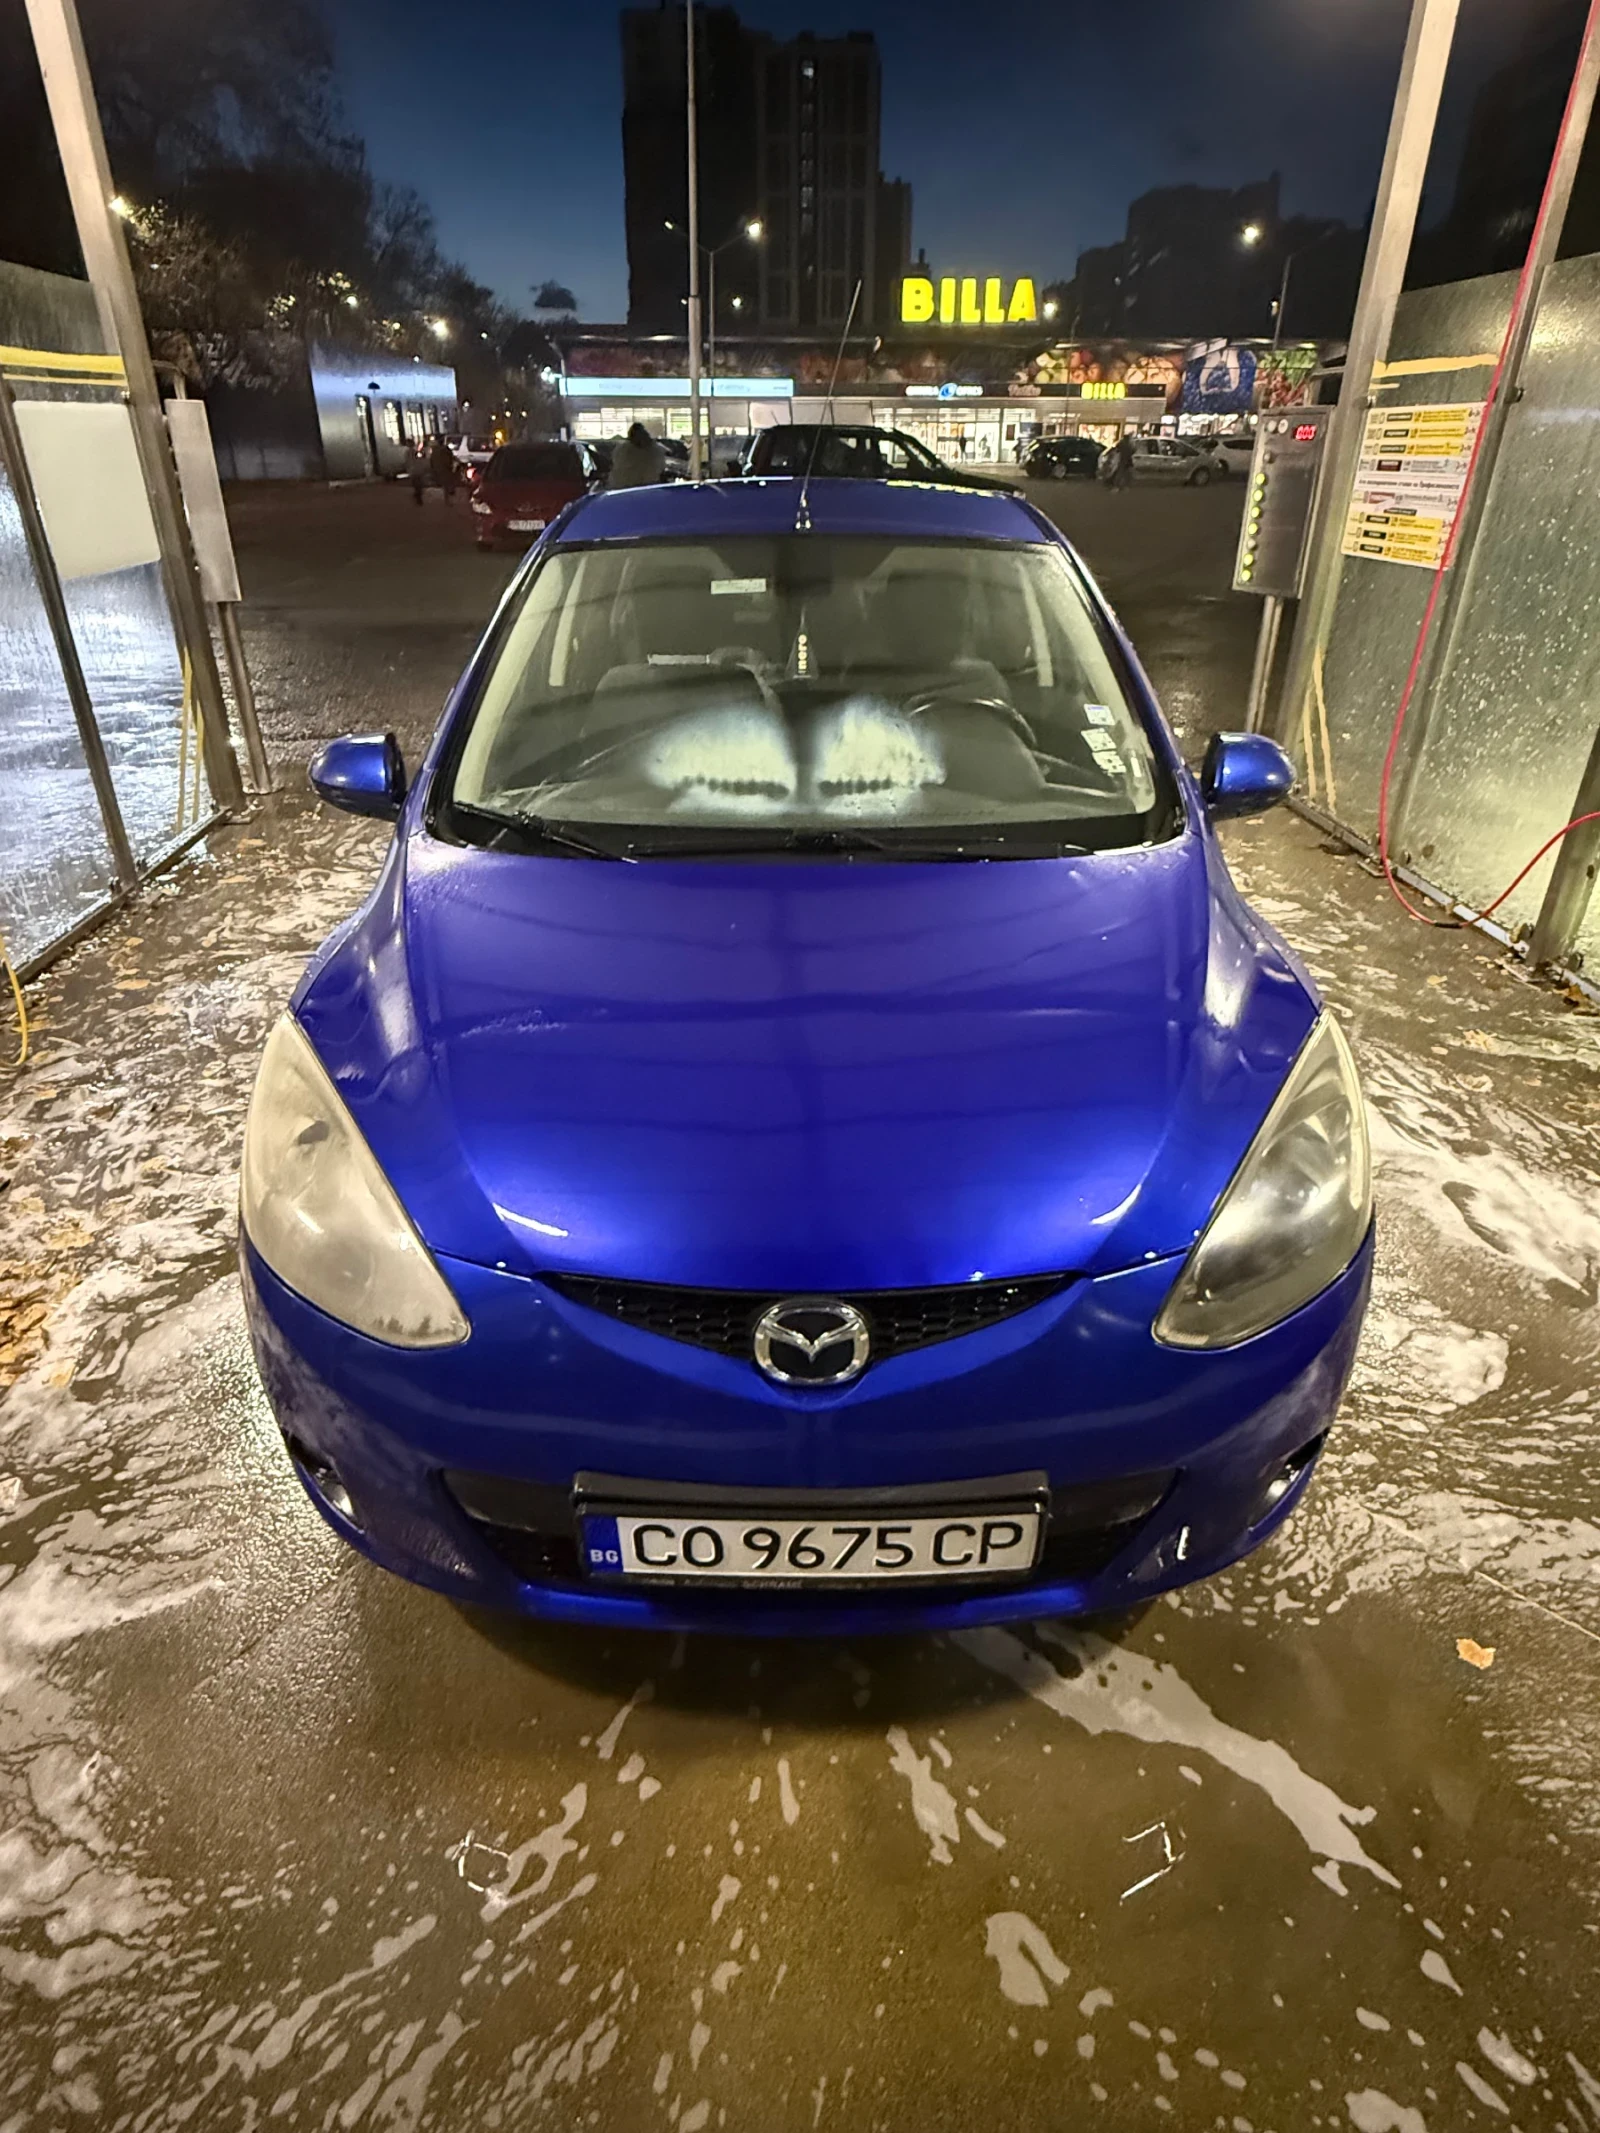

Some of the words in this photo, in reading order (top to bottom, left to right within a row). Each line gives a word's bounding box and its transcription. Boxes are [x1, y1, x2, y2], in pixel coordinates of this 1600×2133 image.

[902, 277, 1036, 323] BILLA
[1081, 382, 1125, 399] BILLA
[590, 1549, 618, 1563] BG
[632, 1524, 724, 1568] CO
[742, 1525, 914, 1570] 9675
[932, 1521, 1024, 1566] CP
